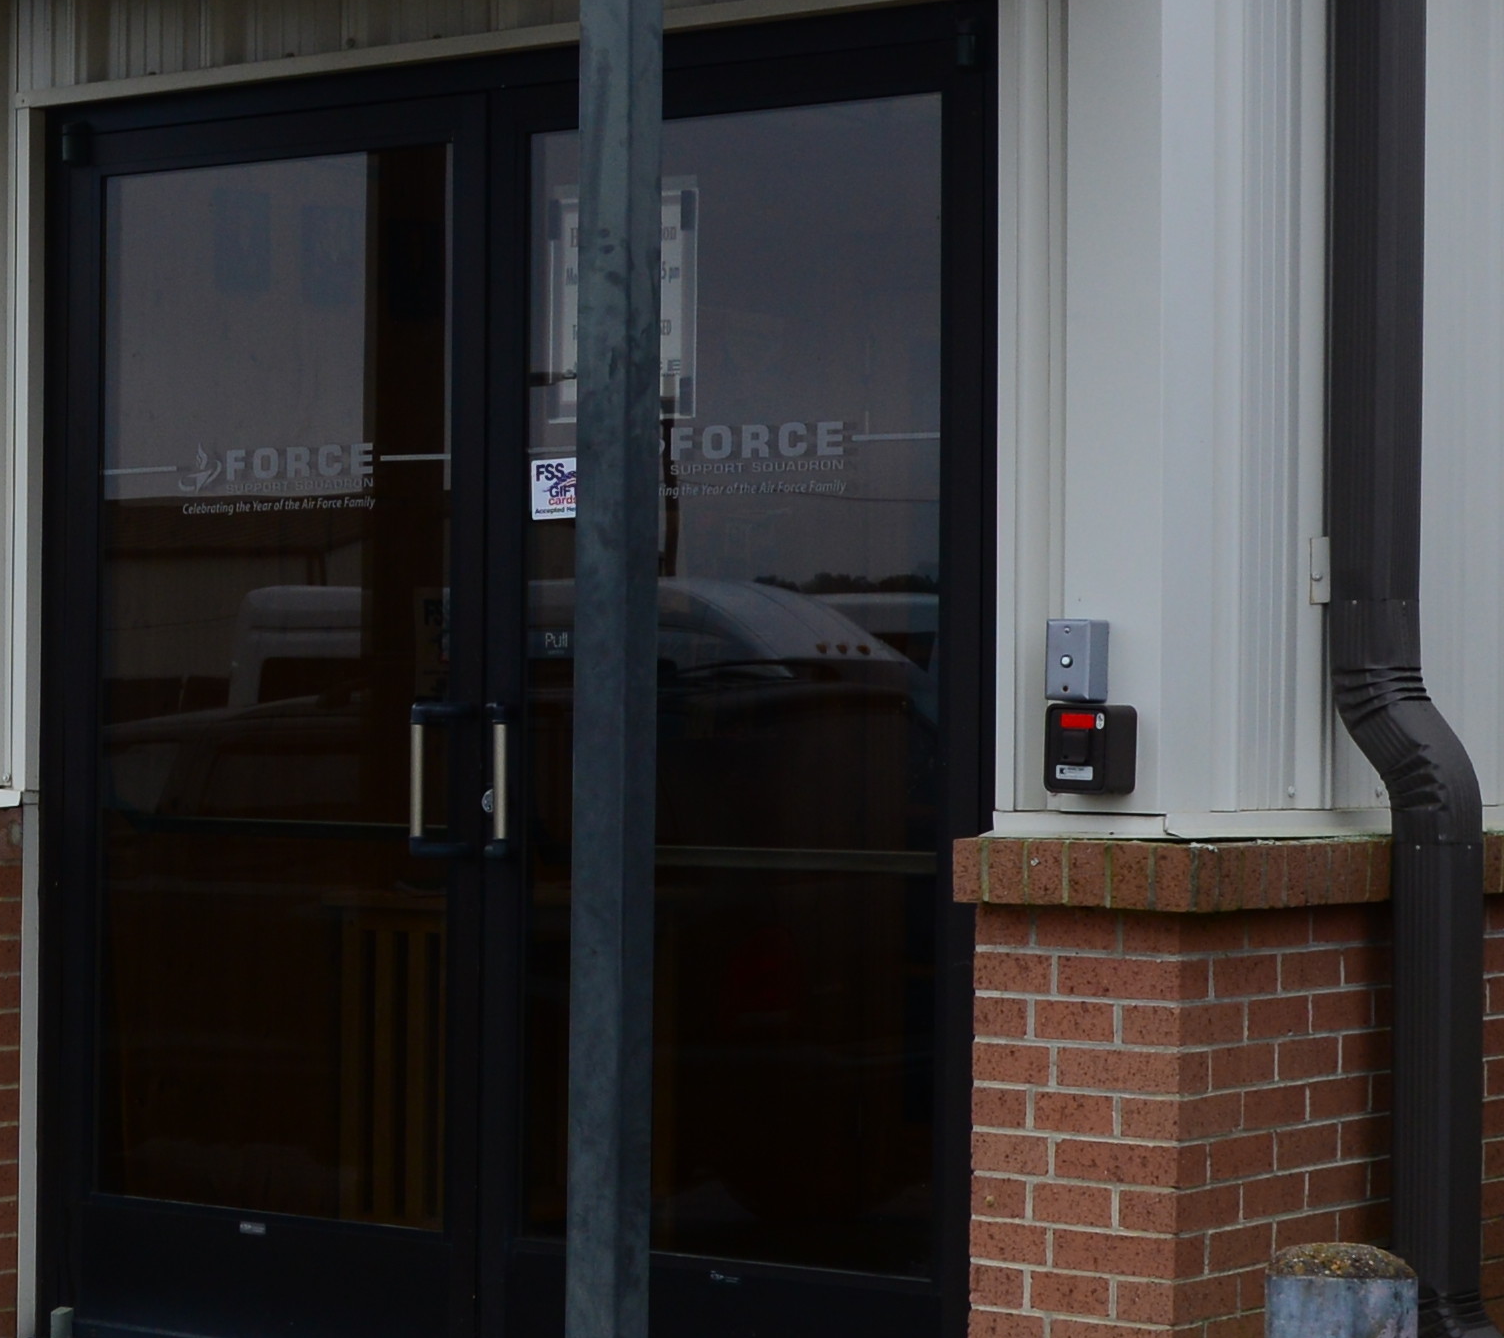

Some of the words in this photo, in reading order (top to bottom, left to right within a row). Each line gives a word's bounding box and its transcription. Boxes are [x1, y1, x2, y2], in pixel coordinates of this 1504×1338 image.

[671, 421, 844, 461] FORCE
[226, 442, 374, 480] FORCE
[670, 462, 744, 475] SUPPORT
[752, 460, 844, 473] SQUADRON
[536, 463, 564, 482] FSS
[226, 481, 289, 495] SUPPORT
[295, 477, 374, 491] SQUADRON
[682, 483, 700, 495] the
[702, 483, 724, 495] Year
[726, 482, 739, 495] of
[740, 482, 756, 494] the
[759, 481, 776, 494] Air
[778, 481, 806, 494] Force
[809, 479, 846, 494] Family
[182, 500, 234, 516] Celebrating
[236, 501, 250, 512] the
[252, 500, 272, 512] Year
[273, 499, 284, 511] of
[285, 499, 299, 510] the
[302, 497, 315, 509] Air
[317, 497, 342, 509] Force
[344, 495, 376, 509] Family
[545, 632, 568, 648] Pull
